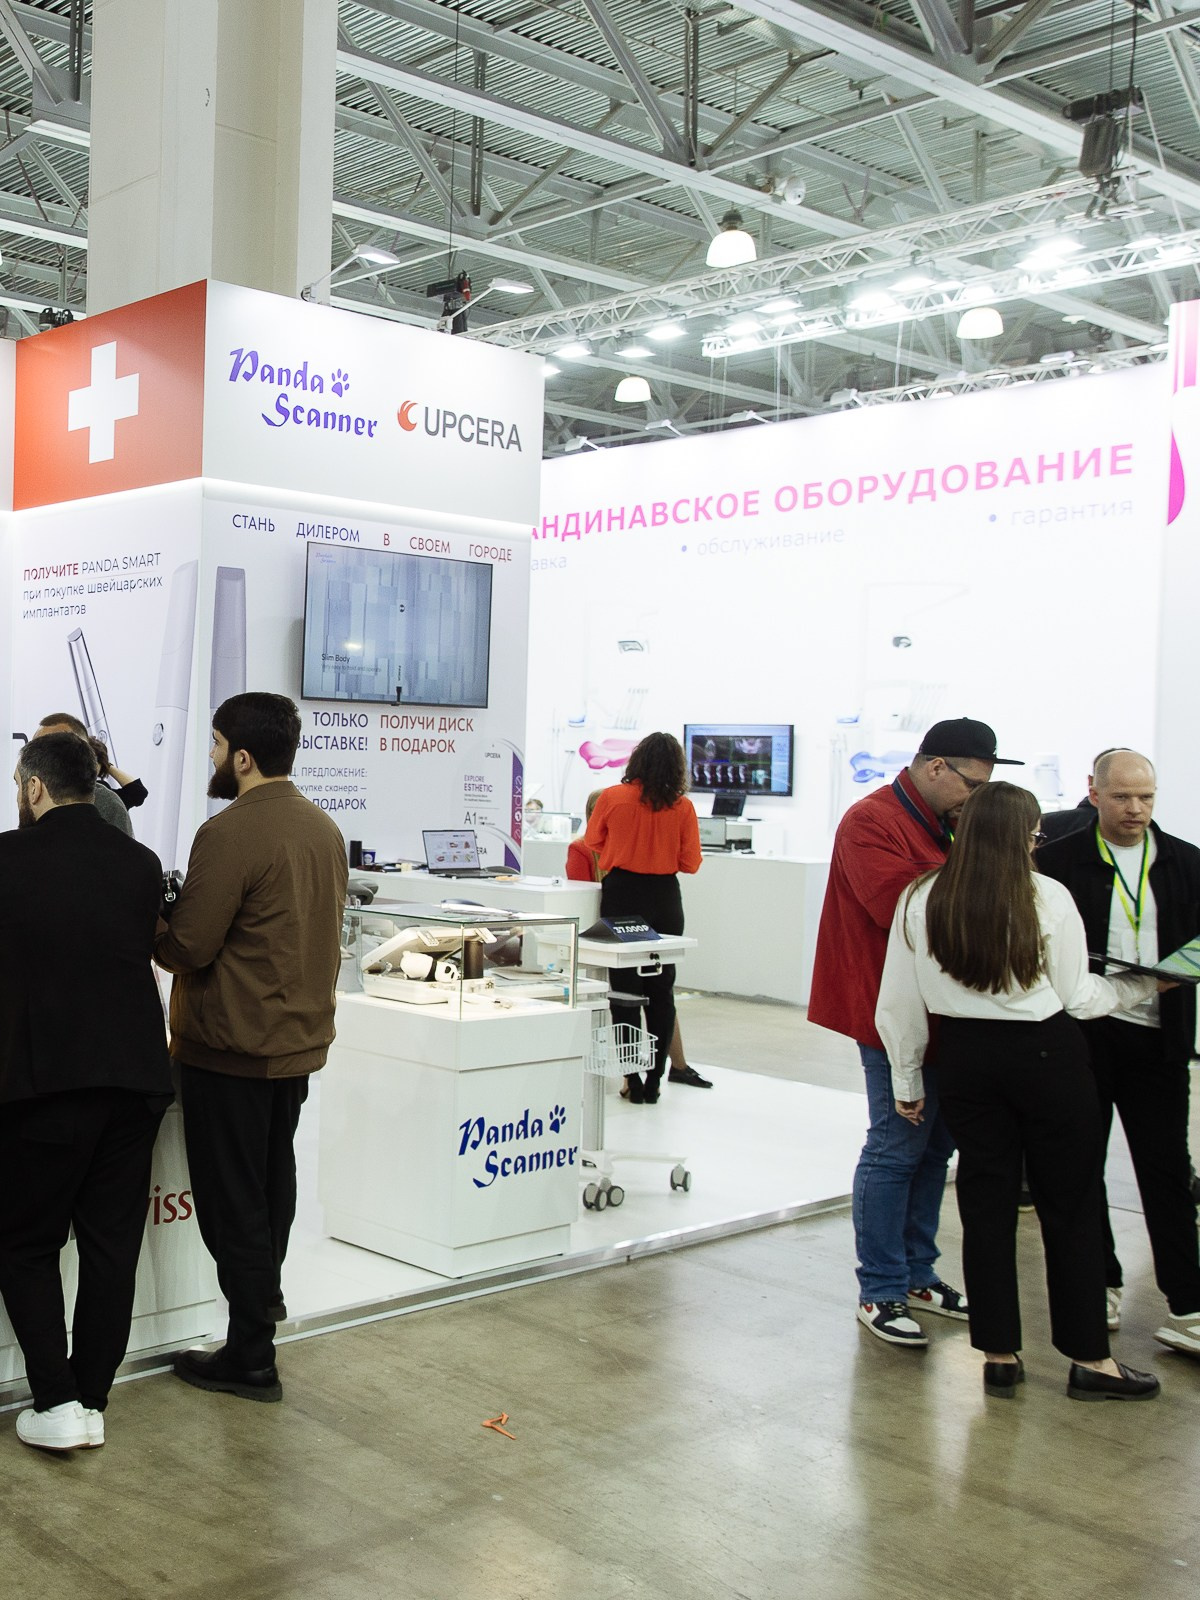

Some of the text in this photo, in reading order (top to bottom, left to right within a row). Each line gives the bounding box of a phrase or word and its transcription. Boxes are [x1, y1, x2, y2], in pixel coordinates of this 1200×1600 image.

[229, 348, 324, 395] Panda
[261, 393, 378, 438] Scanner
[424, 406, 522, 452] UPCERA
[774, 442, 1134, 513] ОБОРУДОВАНИЕ
[1010, 499, 1135, 528] гарантия
[232, 514, 513, 561] СТАНЬ ДИЛЕРОМ В СВОЕМ ГОРОДЕ
[696, 525, 846, 558] обслуживание
[23, 552, 161, 581] ПОЛУЧИТЕ PANDA SMART
[23, 576, 163, 602] при покупке швейцарских
[22, 604, 87, 620] имплантатов
[313, 712, 369, 728] ТОЛЬКО
[380, 715, 474, 733] ПОЛУЧИ ДИСК
[380, 737, 456, 754] В ПОДАРОК
[301, 767, 368, 778] ПРЕДЛОЖЕНИЕ:
[324, 785, 358, 794] сканера
[464, 783, 493, 792] ESTHETIC
[458, 1108, 543, 1156] Panda
[472, 1145, 578, 1188] Scanner
